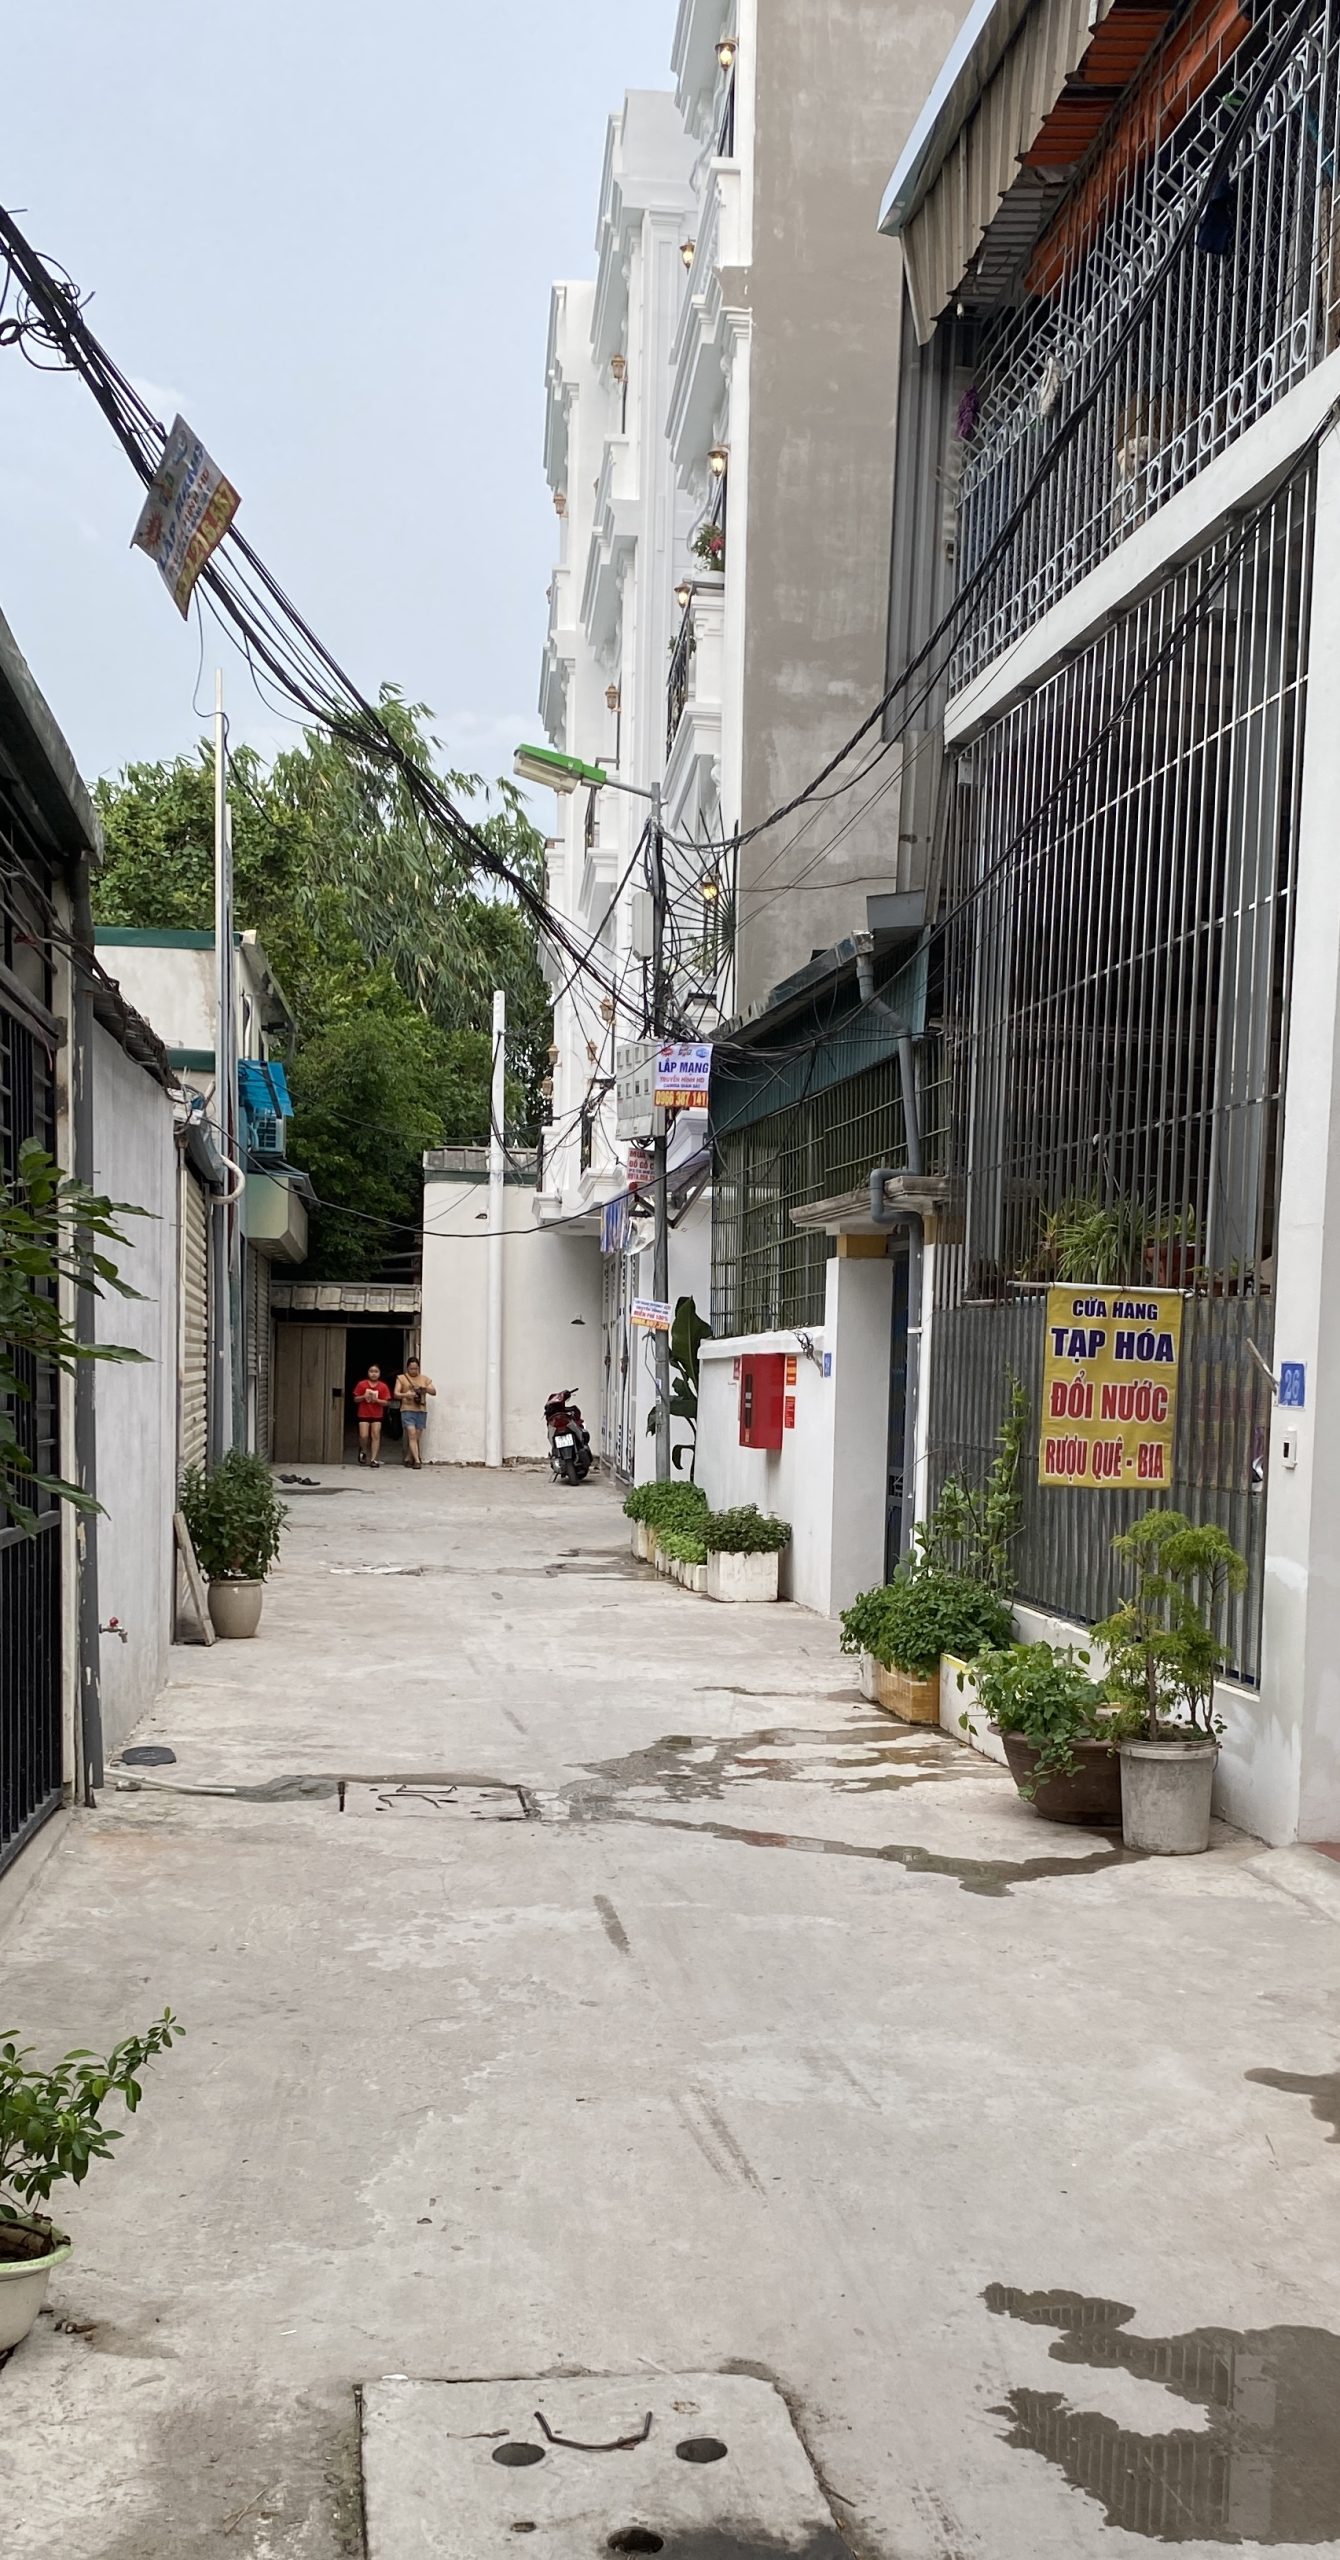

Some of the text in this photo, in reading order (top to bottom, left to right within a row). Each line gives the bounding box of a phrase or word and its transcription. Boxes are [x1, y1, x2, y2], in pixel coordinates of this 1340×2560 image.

[680, 1062, 709, 1075] MẠNG
[1073, 1296, 1158, 1320] CỬA HÀNG
[1051, 1328, 1174, 1363] TẠP HÓA
[1051, 1370, 1168, 1422] ĐỔI NƯỚC
[1284, 1370, 1300, 1399] 26
[1046, 1435, 1087, 1482] RƯỢU
[1092, 1436, 1123, 1480] QUÊ
[1138, 1444, 1164, 1478] BIA
